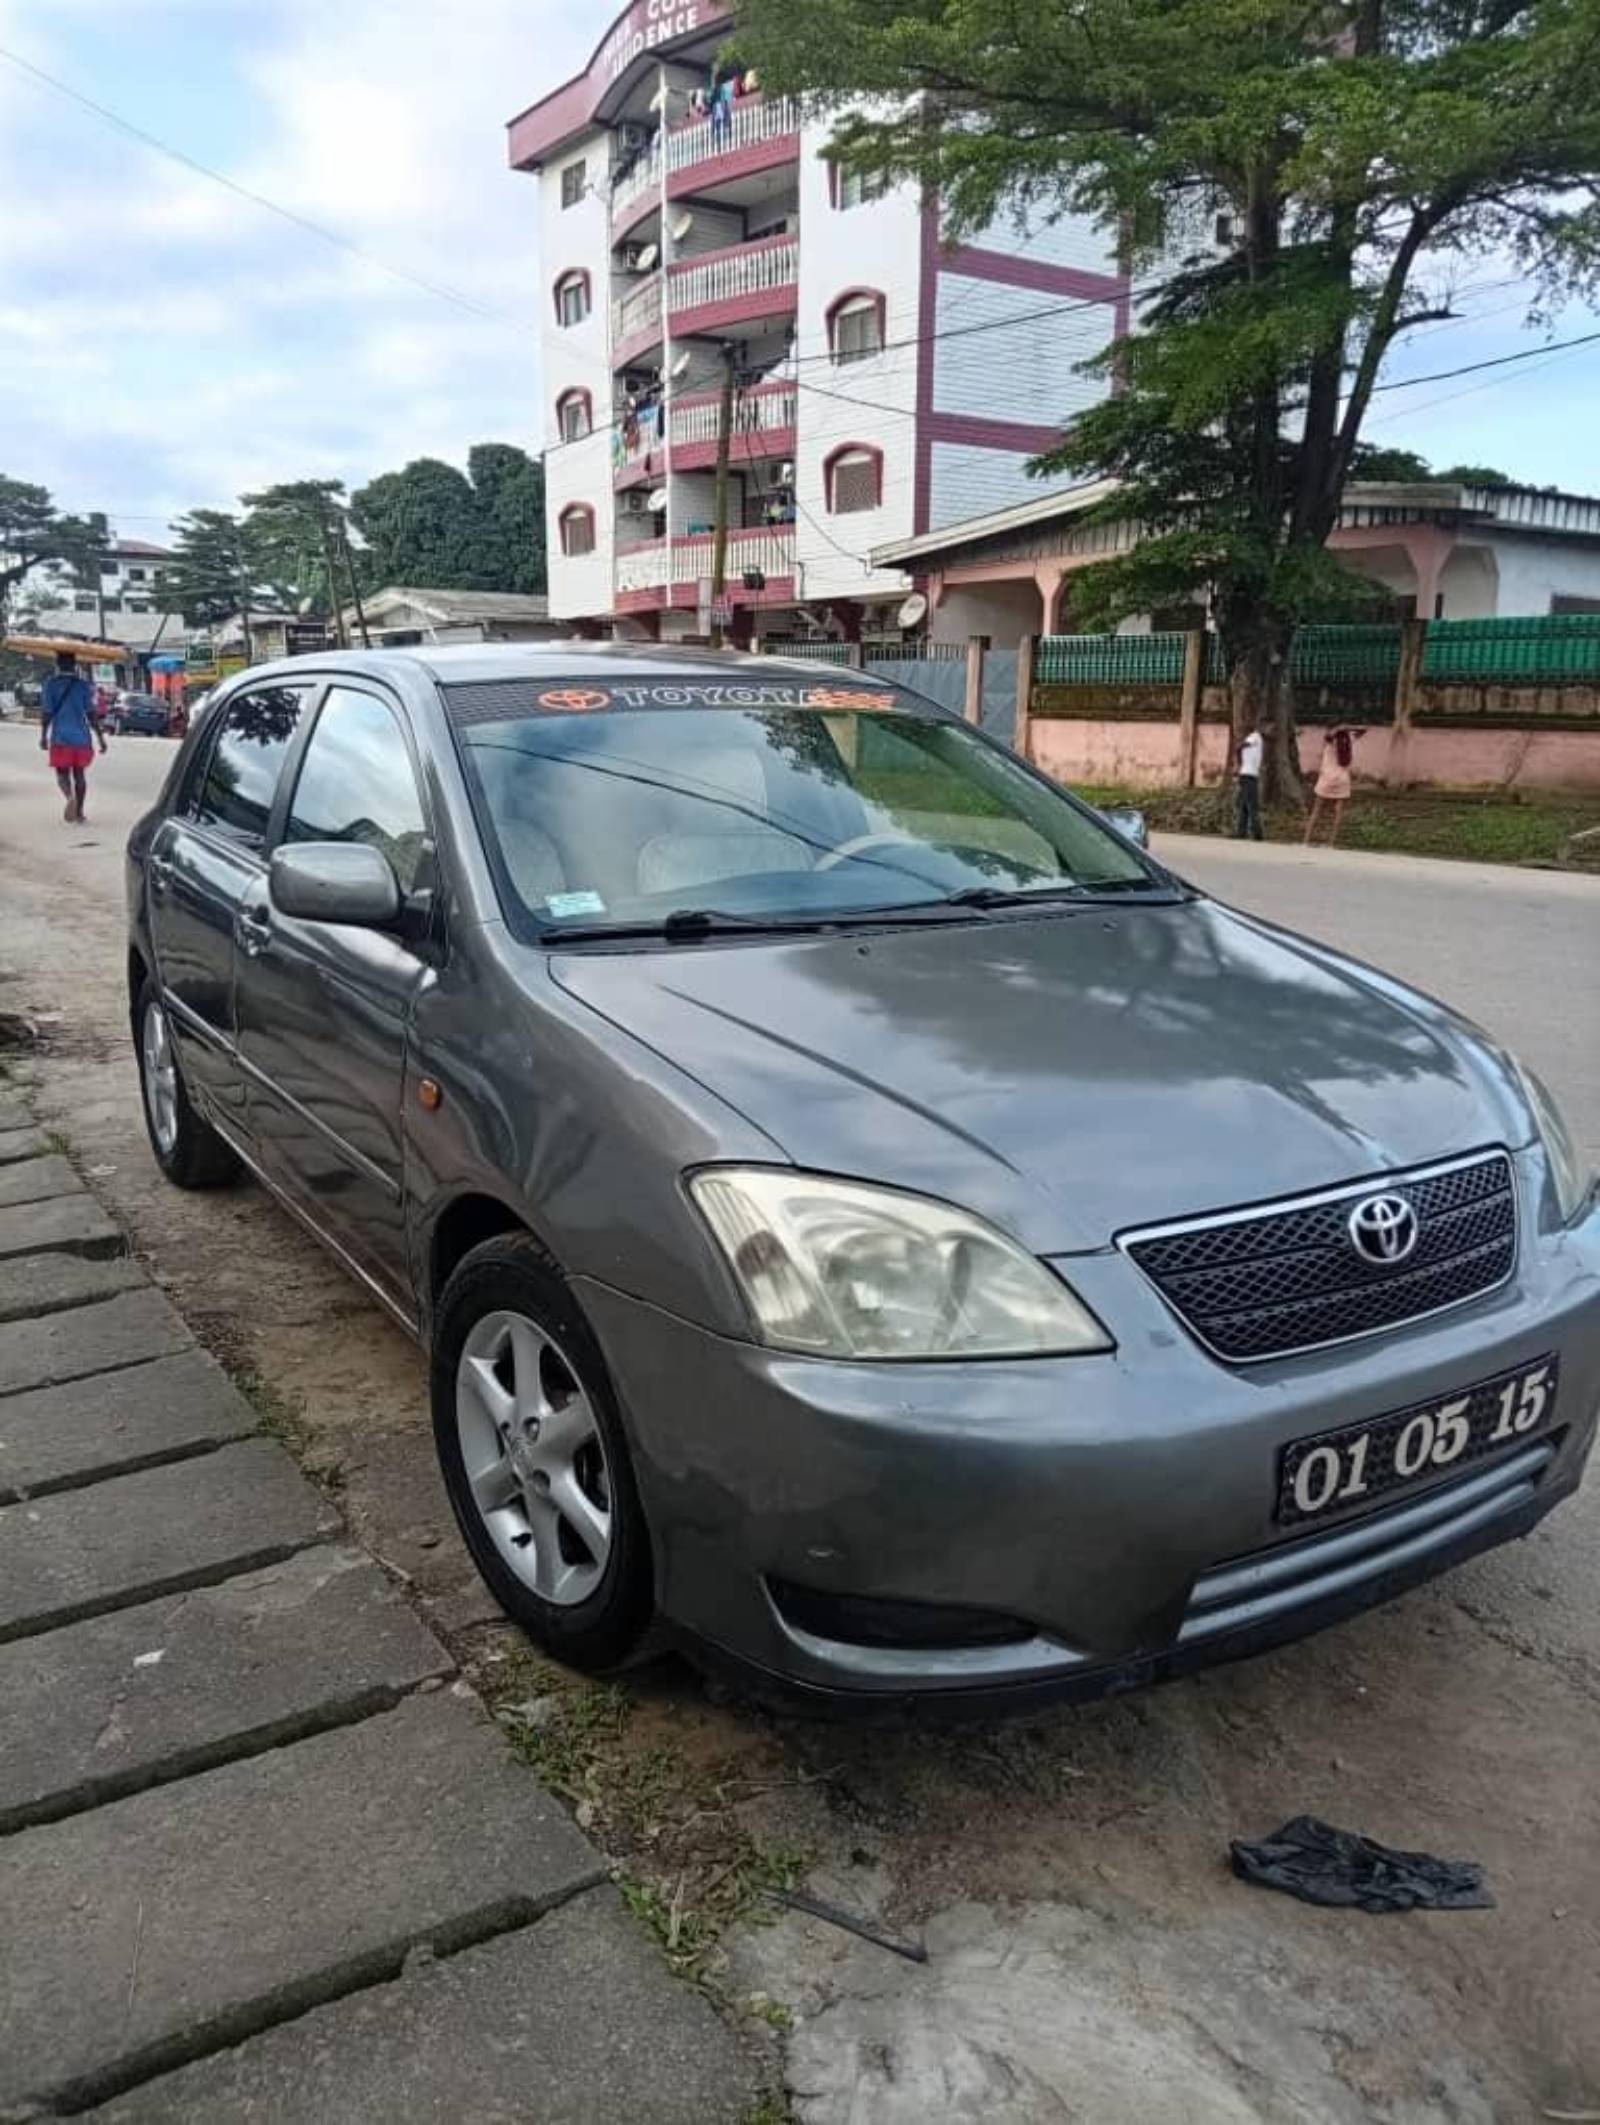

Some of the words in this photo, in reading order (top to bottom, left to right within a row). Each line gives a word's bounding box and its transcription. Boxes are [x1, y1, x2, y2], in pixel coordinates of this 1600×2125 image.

[1294, 1432, 1371, 1512] 01
[1394, 1397, 1471, 1476] 05
[1489, 1366, 1549, 1441] 15
